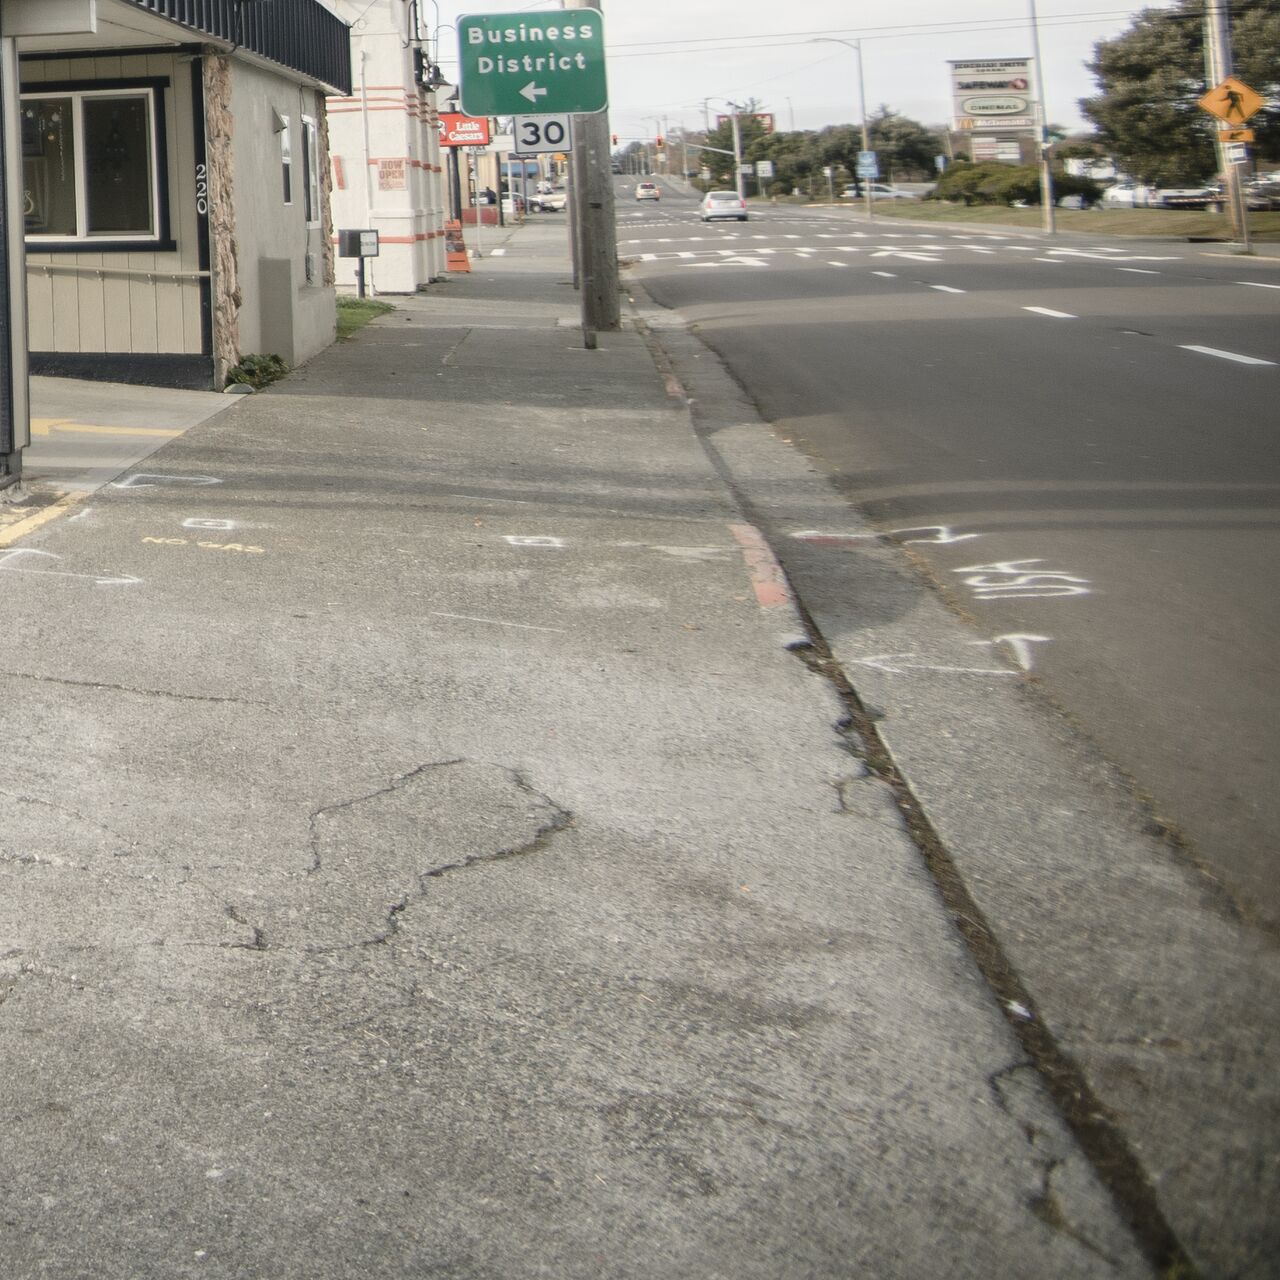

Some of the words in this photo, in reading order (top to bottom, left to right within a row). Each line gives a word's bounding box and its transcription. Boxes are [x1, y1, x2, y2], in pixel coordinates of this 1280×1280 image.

[467, 23, 593, 45] Business
[477, 52, 586, 74] District
[956, 80, 1009, 90] SAFEWAY
[455, 121, 480, 131] Little
[521, 120, 564, 146] 30
[380, 160, 402, 170] NOW
[379, 170, 404, 179] OPEN
[196, 163, 207, 215] 220
[141, 536, 188, 545] NO
